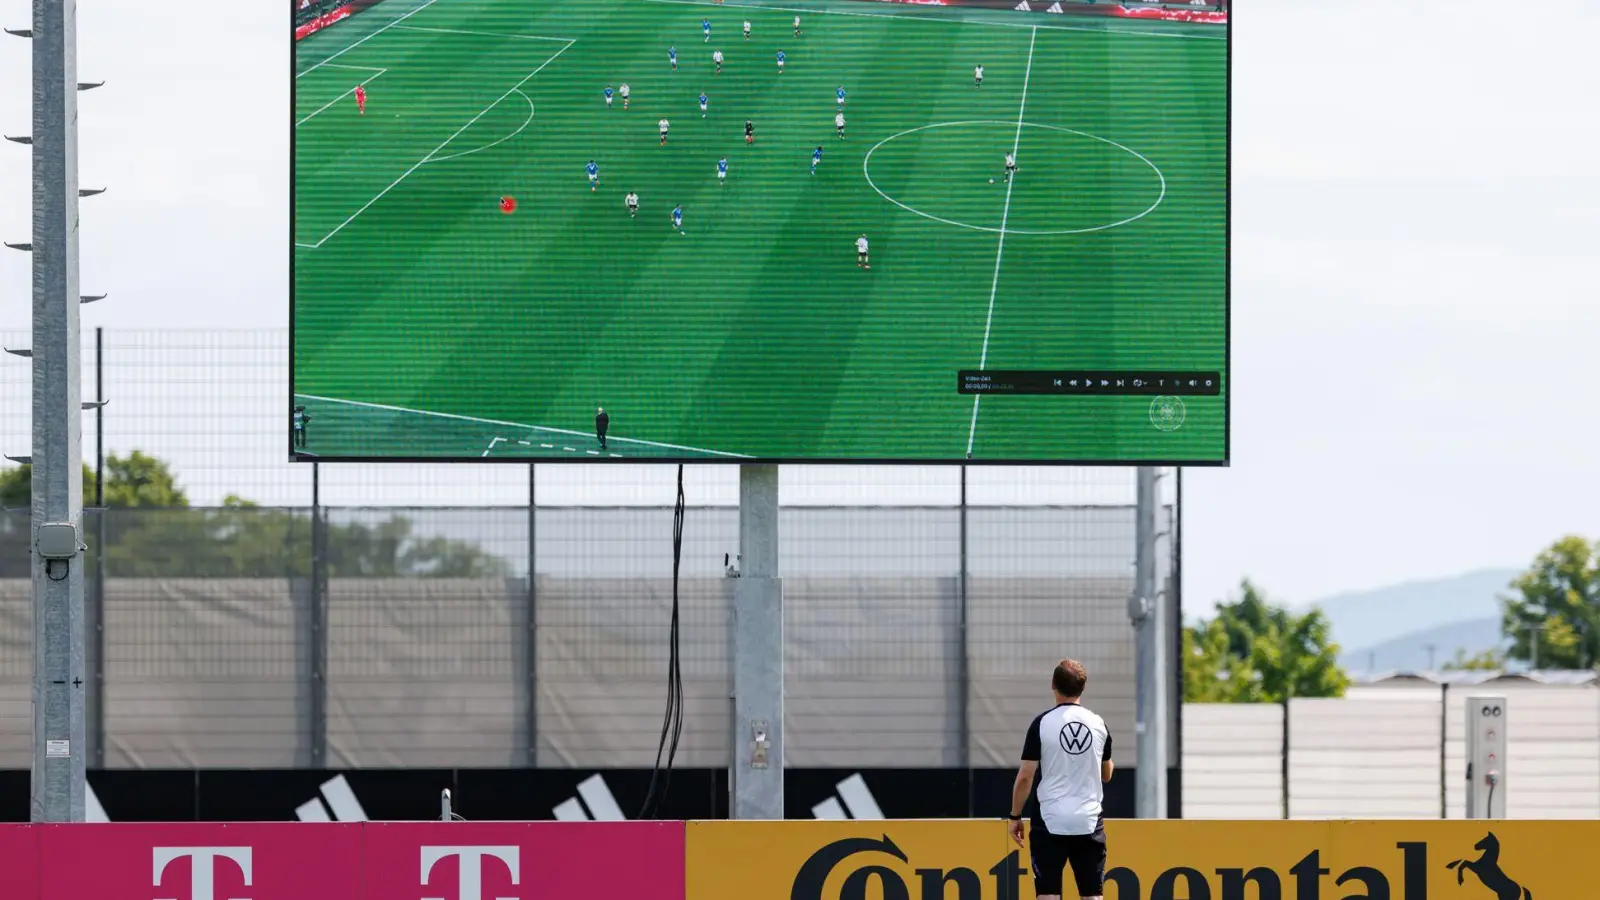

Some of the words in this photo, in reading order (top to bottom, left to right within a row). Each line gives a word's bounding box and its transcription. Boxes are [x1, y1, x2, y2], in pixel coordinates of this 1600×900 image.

[1060, 722, 1092, 754] VW
[152, 846, 253, 900] T
[420, 845, 520, 900] T
[790, 832, 1427, 900] Contental
